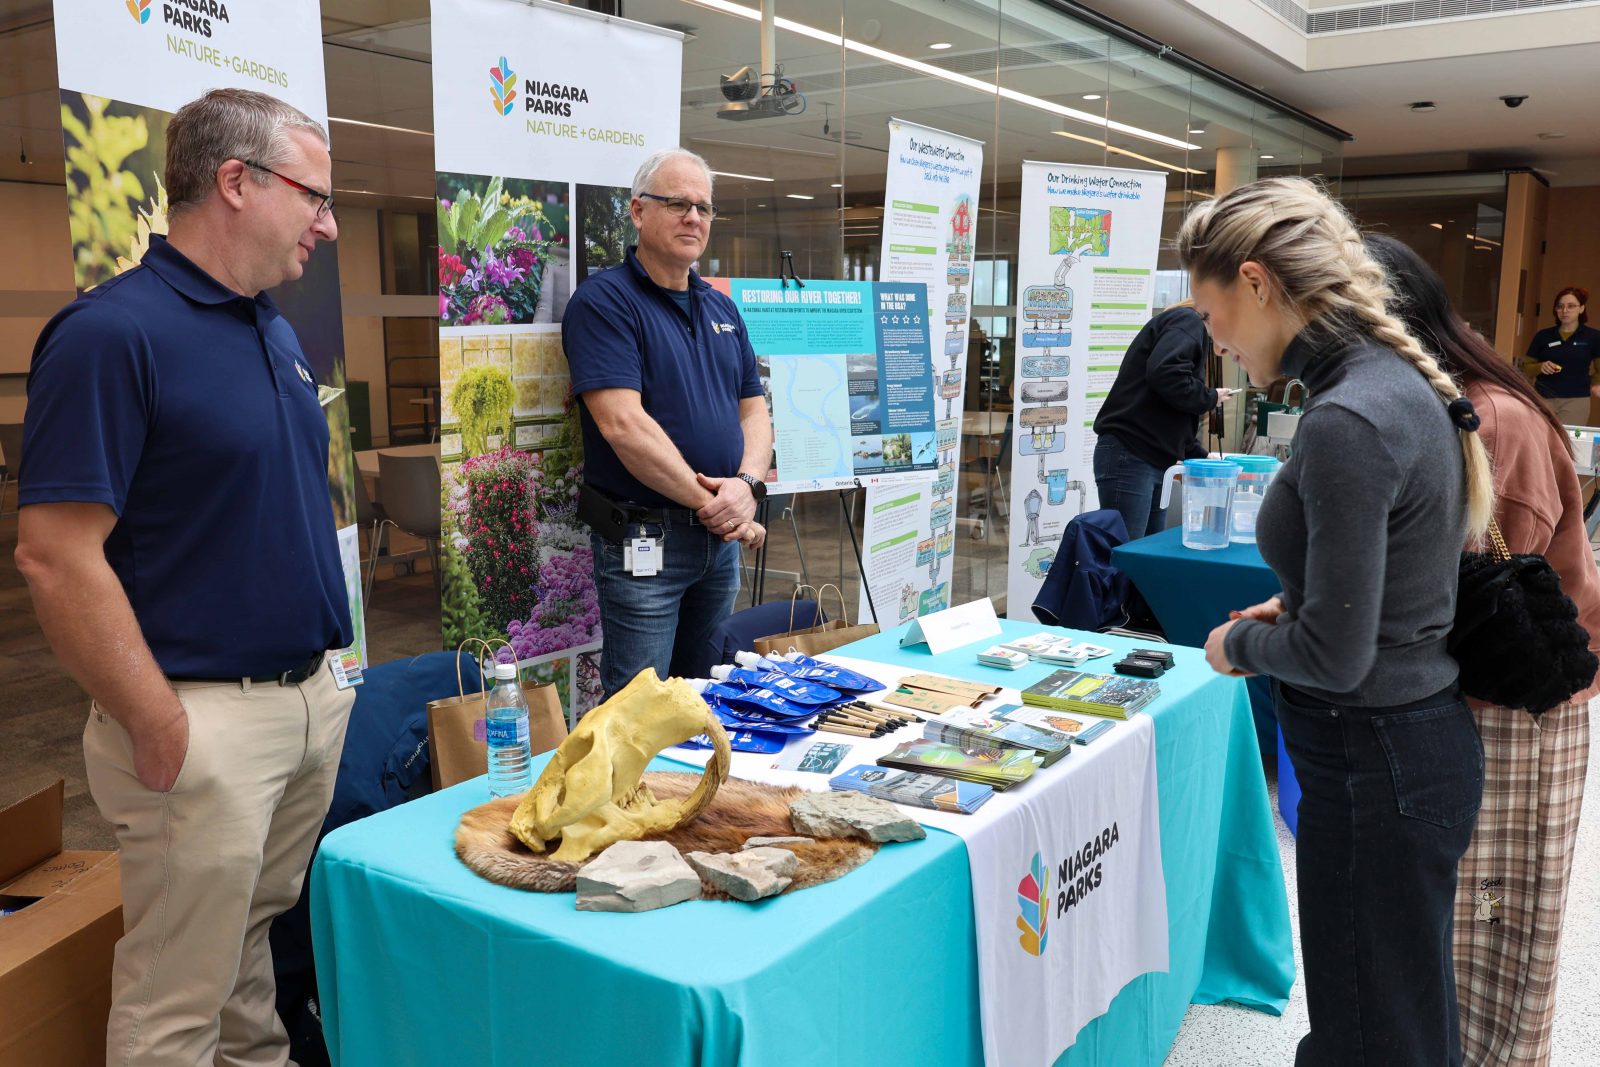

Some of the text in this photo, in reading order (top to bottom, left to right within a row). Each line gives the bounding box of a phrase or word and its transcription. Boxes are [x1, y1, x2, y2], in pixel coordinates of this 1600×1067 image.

[163, 4, 212, 38] PARKS
[166, 33, 222, 68] NATURE
[232, 56, 288, 88] GARDENS
[525, 79, 589, 103] NIAGARA
[525, 97, 572, 117] PARKS
[526, 119, 578, 139] NATURE
[588, 127, 645, 147] GARDENS
[1047, 172, 1142, 190] Our Drinking Water Connection
[1047, 185, 1141, 200] How we make Niagara's water drinkable
[742, 289, 861, 305] RESTORING OUR RIVER TOGETHER!
[880, 293, 894, 301] WHAT
[1058, 821, 1119, 889] NIAGARA
[1057, 862, 1102, 920] PARKS
